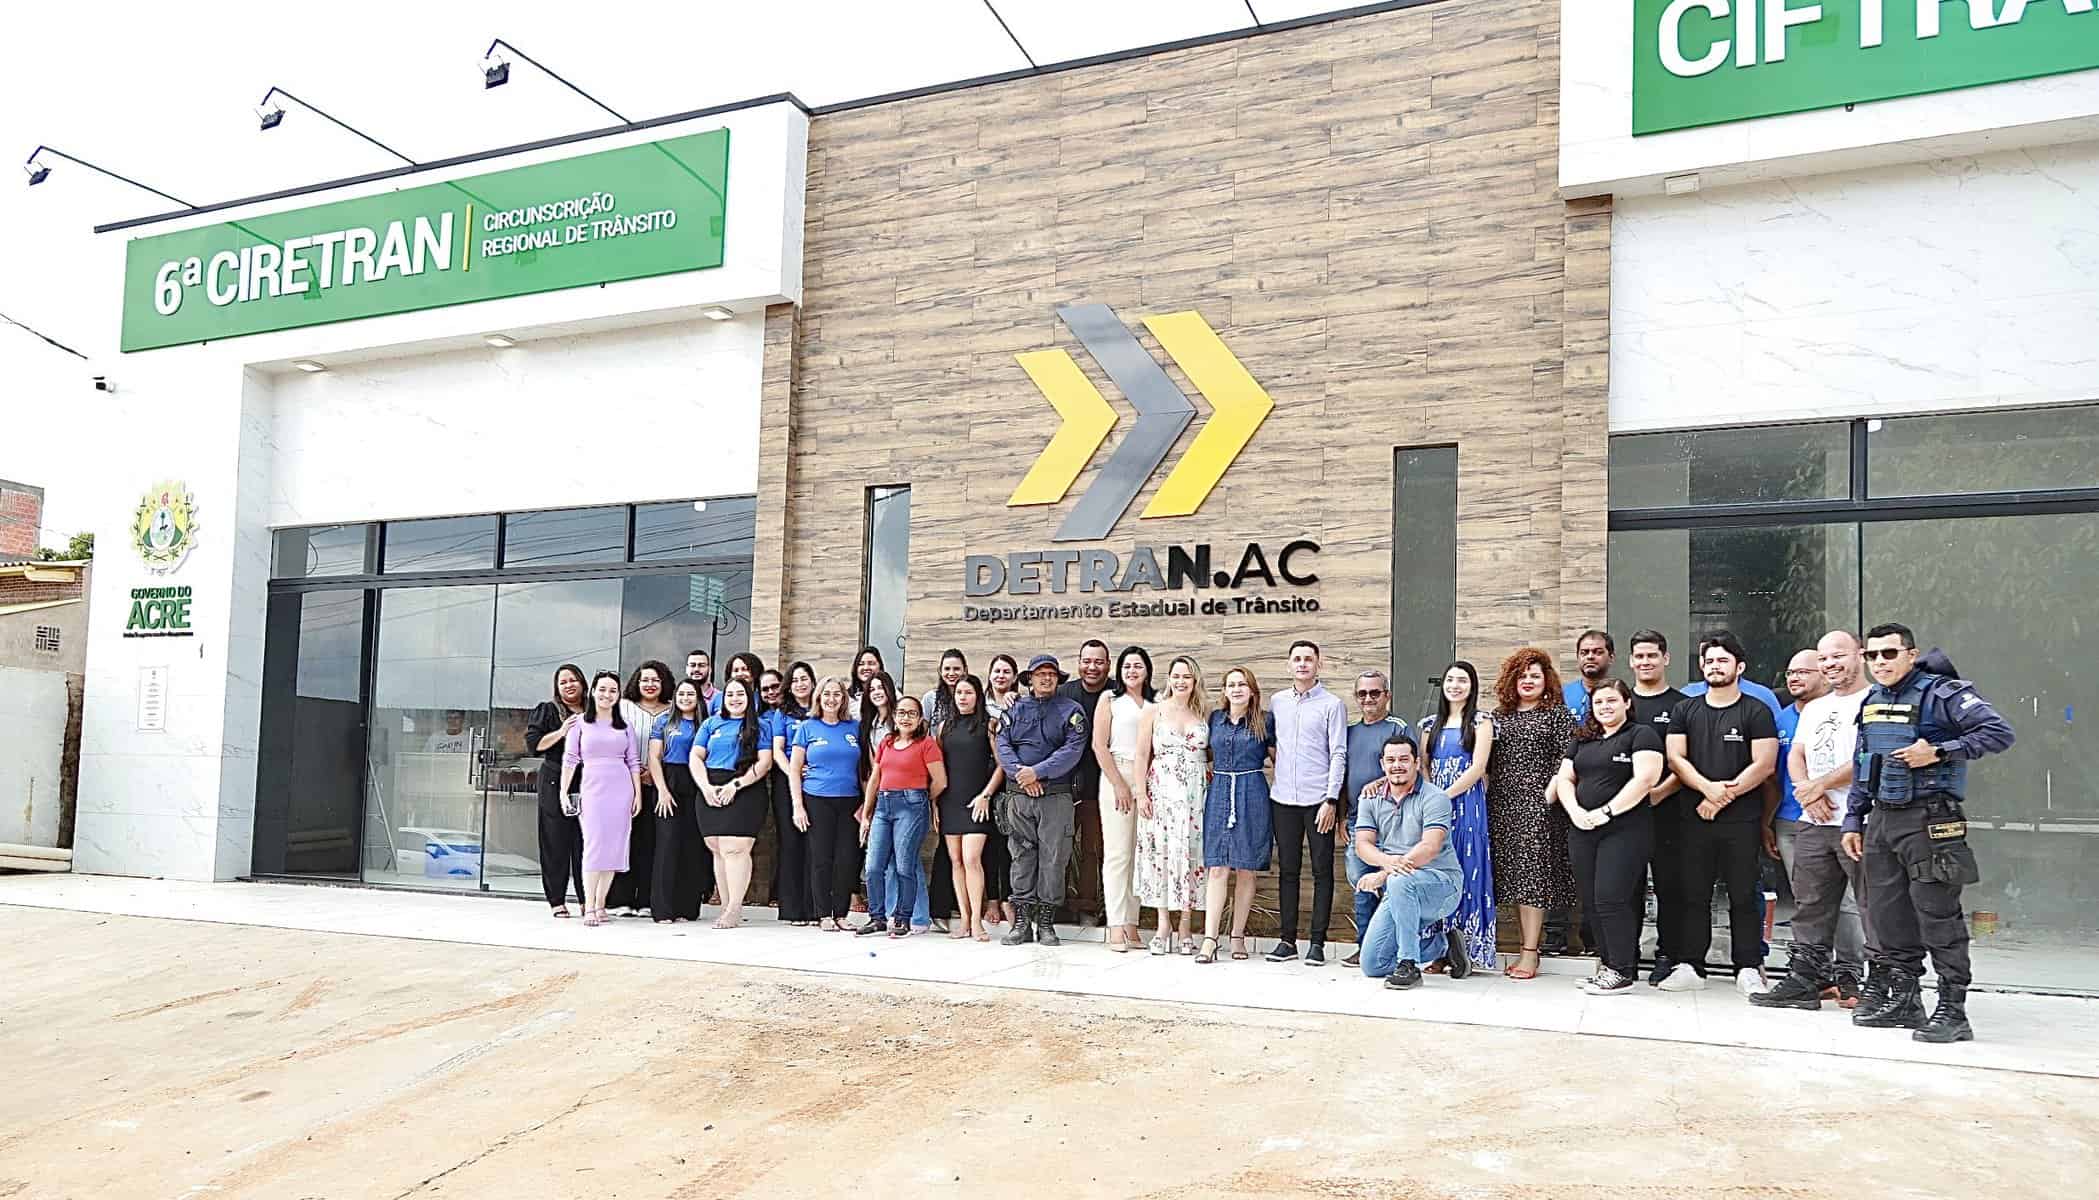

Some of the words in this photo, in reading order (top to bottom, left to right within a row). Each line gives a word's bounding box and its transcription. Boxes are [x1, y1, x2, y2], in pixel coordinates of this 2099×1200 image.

[484, 191, 616, 232] CIRCUNSCRIÇÃO
[481, 228, 562, 258] REGIONAL
[565, 223, 591, 245] DE
[590, 209, 677, 241] TRÂNSITO
[206, 212, 455, 307] CIRETRAN
[963, 539, 1321, 598] DETRAN.AC
[131, 586, 176, 599] GOVERNO
[177, 585, 192, 598] DO
[964, 604, 1103, 624] Departamento
[1108, 598, 1195, 618] Estadual
[1200, 597, 1227, 616] de
[1231, 595, 1320, 614] Trânsito
[126, 598, 192, 630] ACRE
